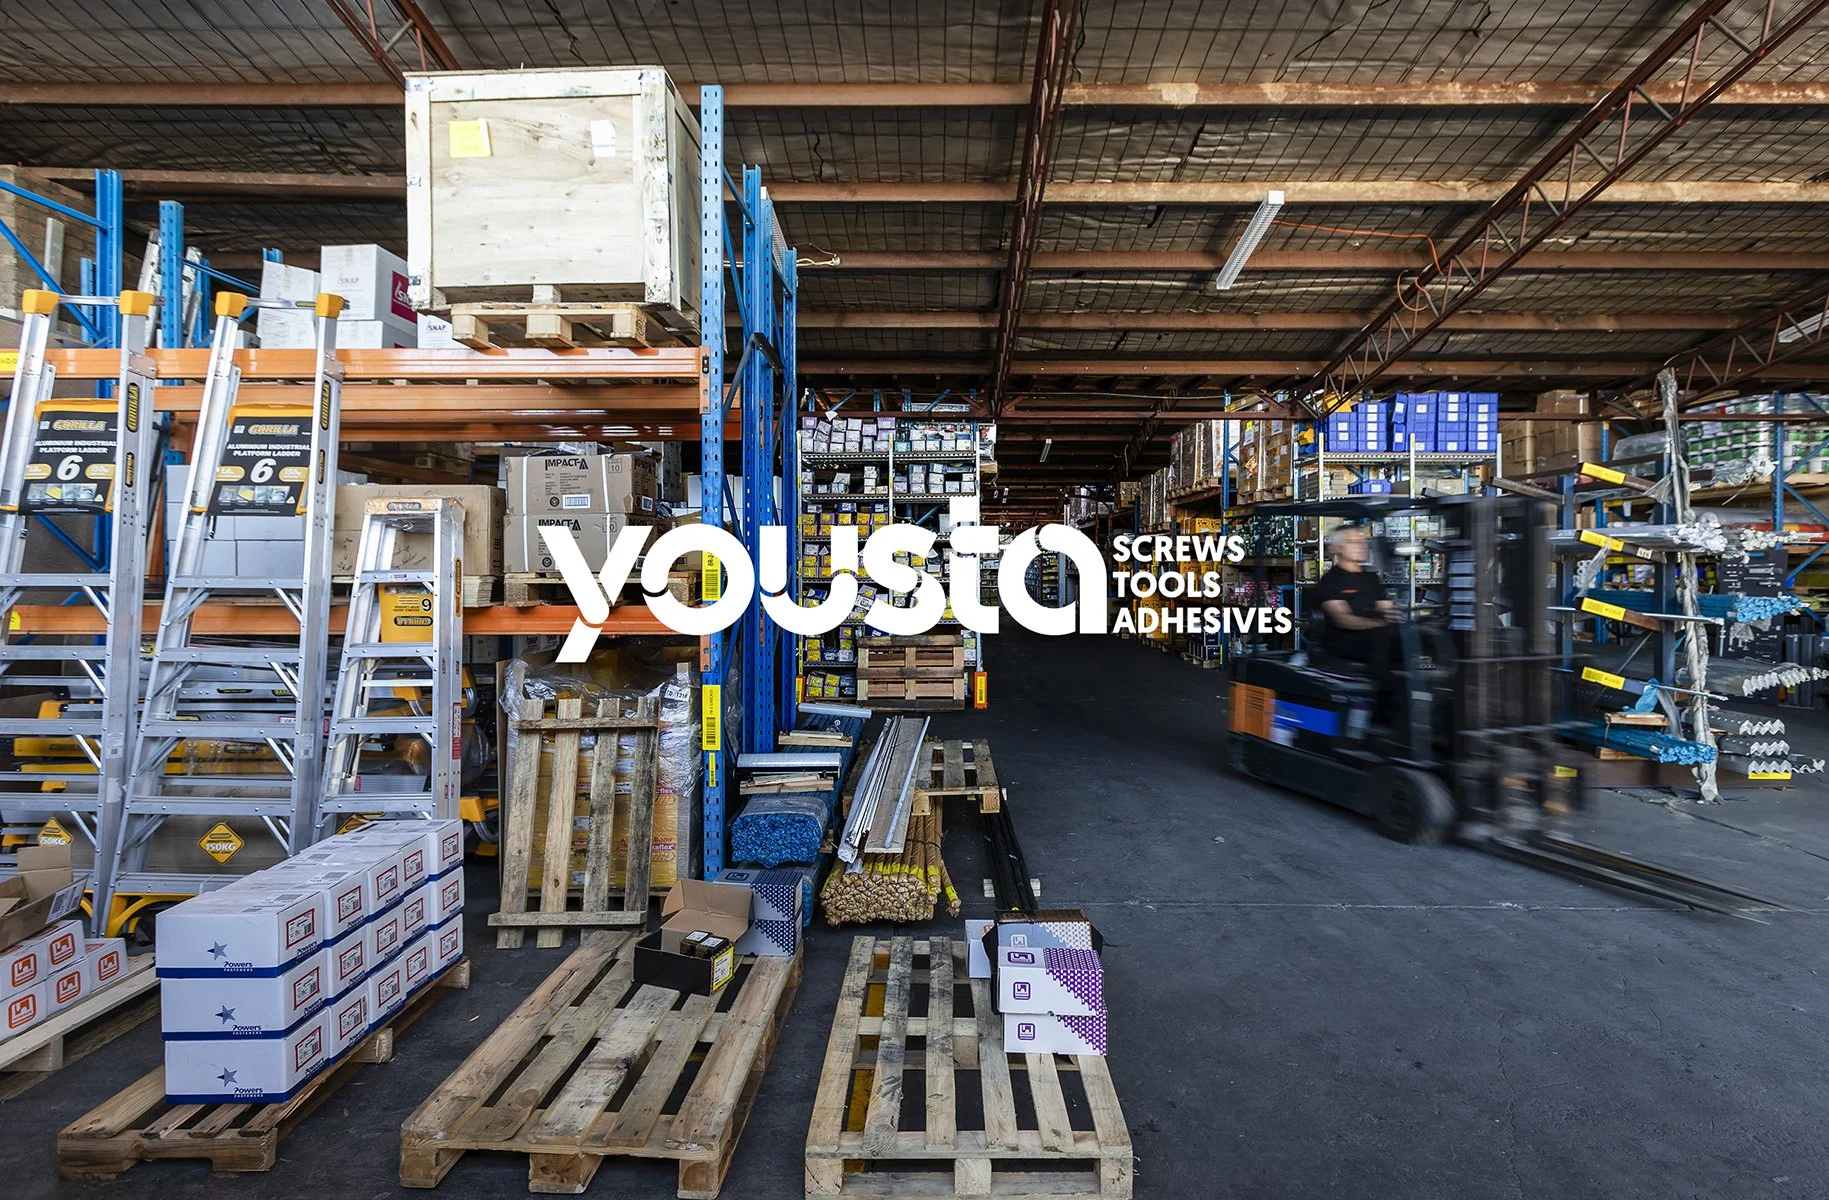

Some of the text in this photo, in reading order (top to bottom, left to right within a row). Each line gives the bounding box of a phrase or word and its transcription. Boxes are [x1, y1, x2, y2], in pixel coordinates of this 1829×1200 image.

[128, 384, 138, 430] GORILLA
[52, 420, 107, 432] GORILLA
[248, 424, 300, 436] GORILLA
[56, 455, 83, 480] 6
[250, 458, 276, 483] 6
[545, 458, 588, 471] IMPACT-A
[297, 941, 318, 955] Powers
